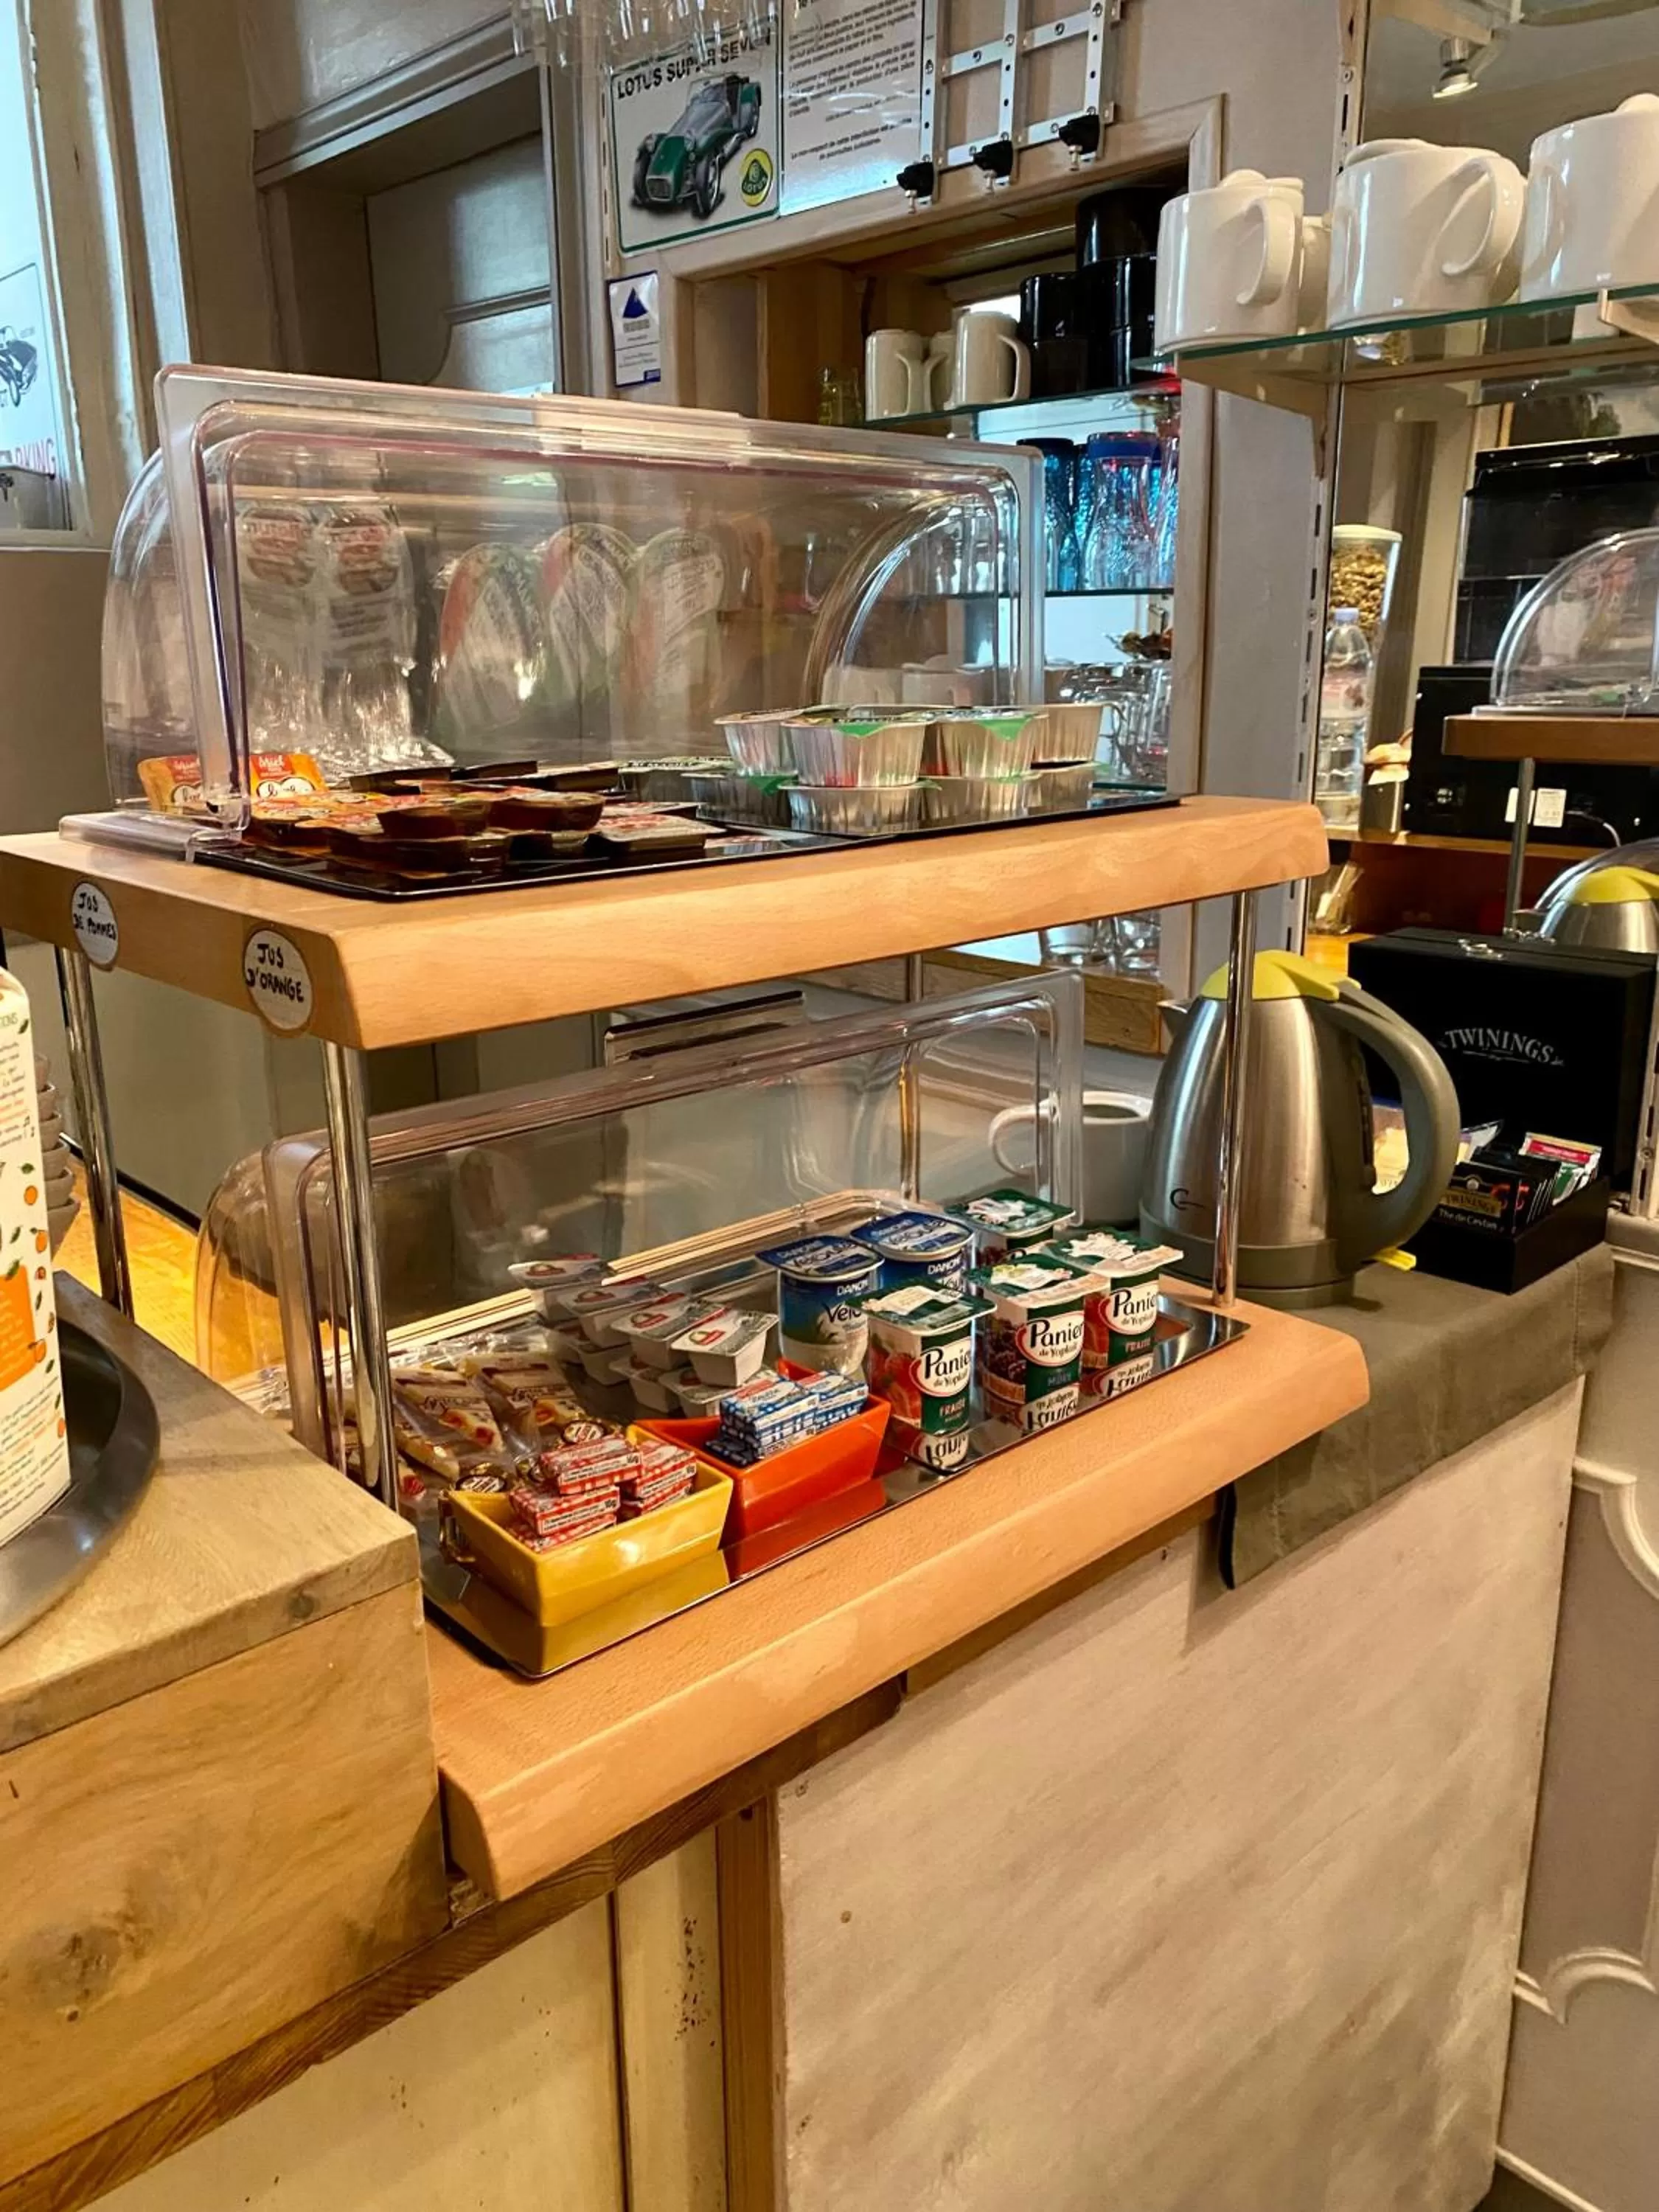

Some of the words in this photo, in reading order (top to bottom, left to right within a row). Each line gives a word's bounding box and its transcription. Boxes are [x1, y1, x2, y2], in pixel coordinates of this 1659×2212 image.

[617, 67, 663, 99] LOTUS
[77, 891, 98, 913] JUS
[257, 943, 284, 969] JUS
[245, 967, 305, 1003] D'ORANGE
[1444, 1027, 1554, 1063] TWININGS
[1026, 1319, 1083, 1349] Panier
[1038, 1349, 1049, 1357] de
